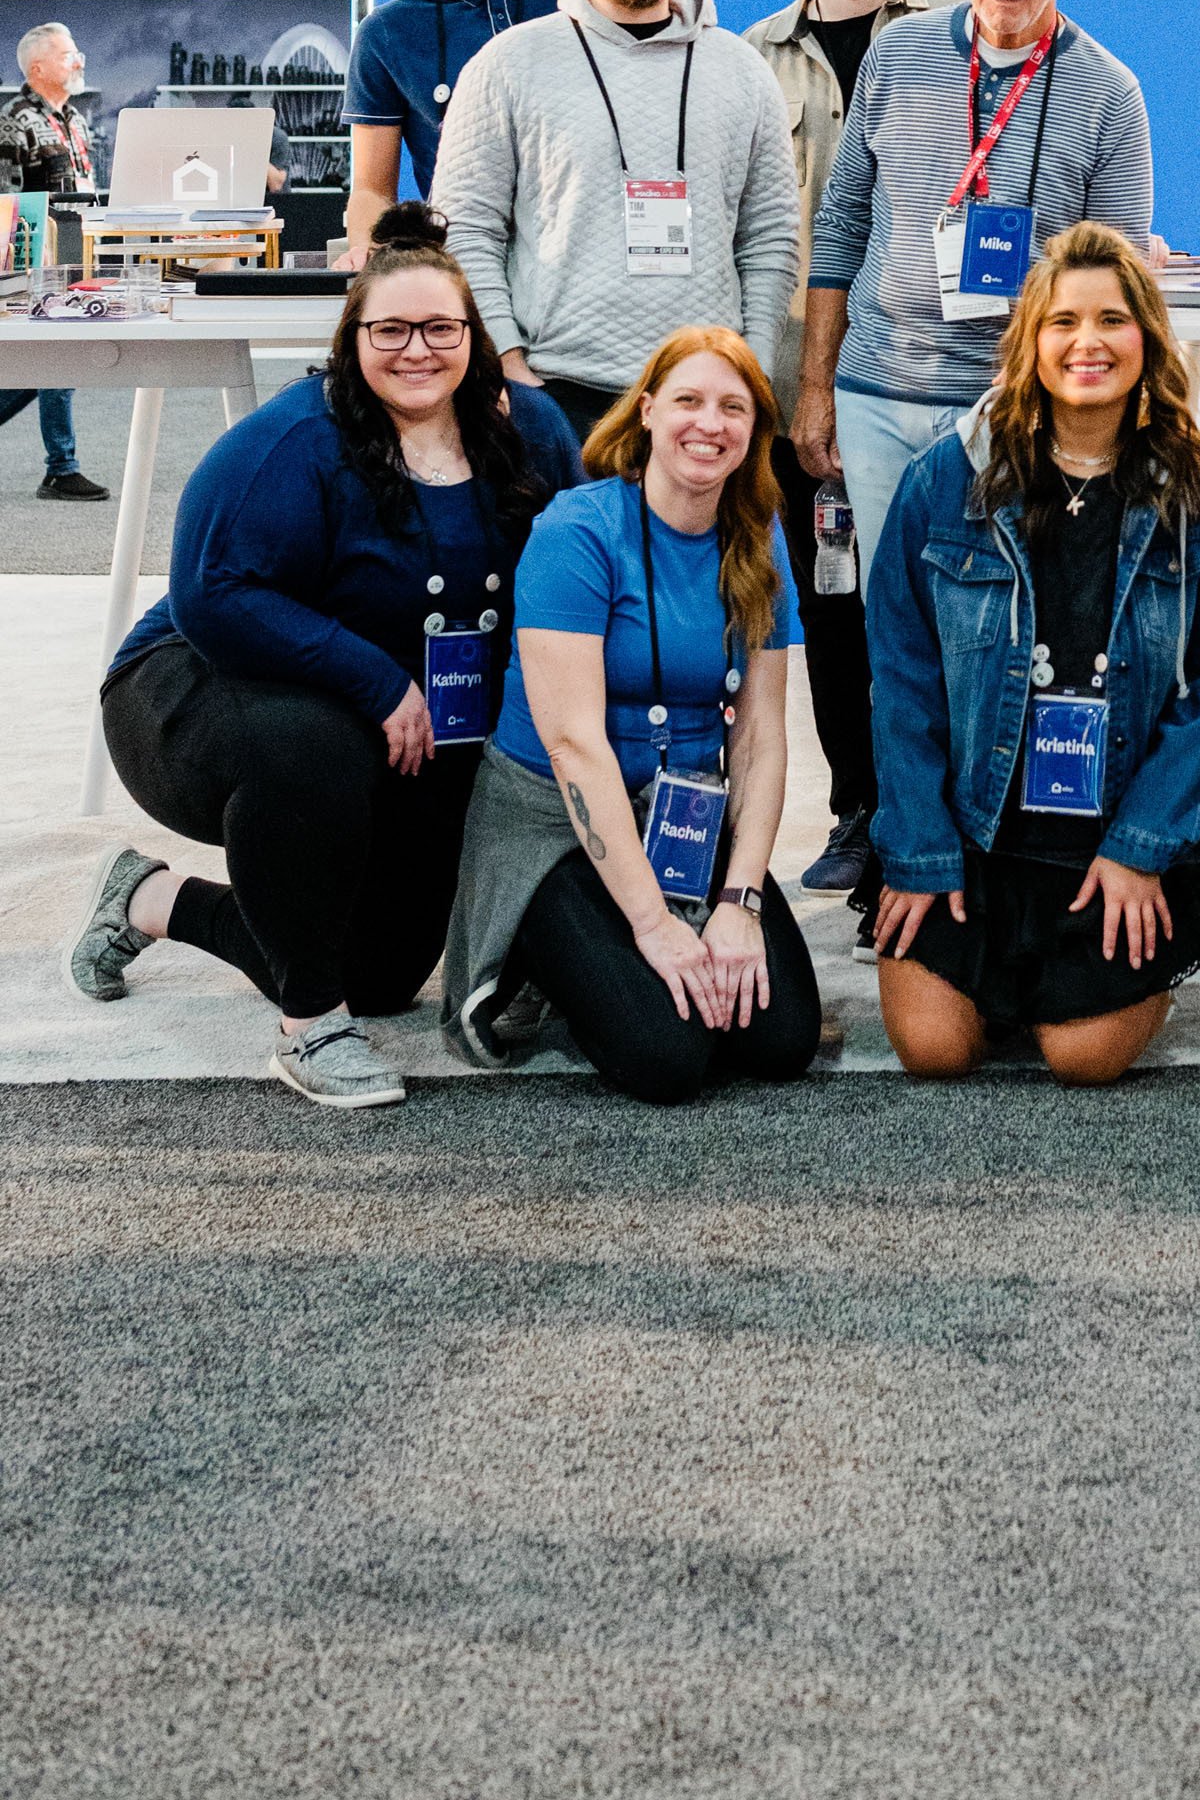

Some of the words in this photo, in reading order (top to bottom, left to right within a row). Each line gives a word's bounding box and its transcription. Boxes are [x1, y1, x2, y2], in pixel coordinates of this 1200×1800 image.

[980, 236, 1013, 252] Mike
[432, 671, 482, 688] Kathryn
[1036, 736, 1096, 756] Kristina
[659, 820, 707, 844] Rachel
